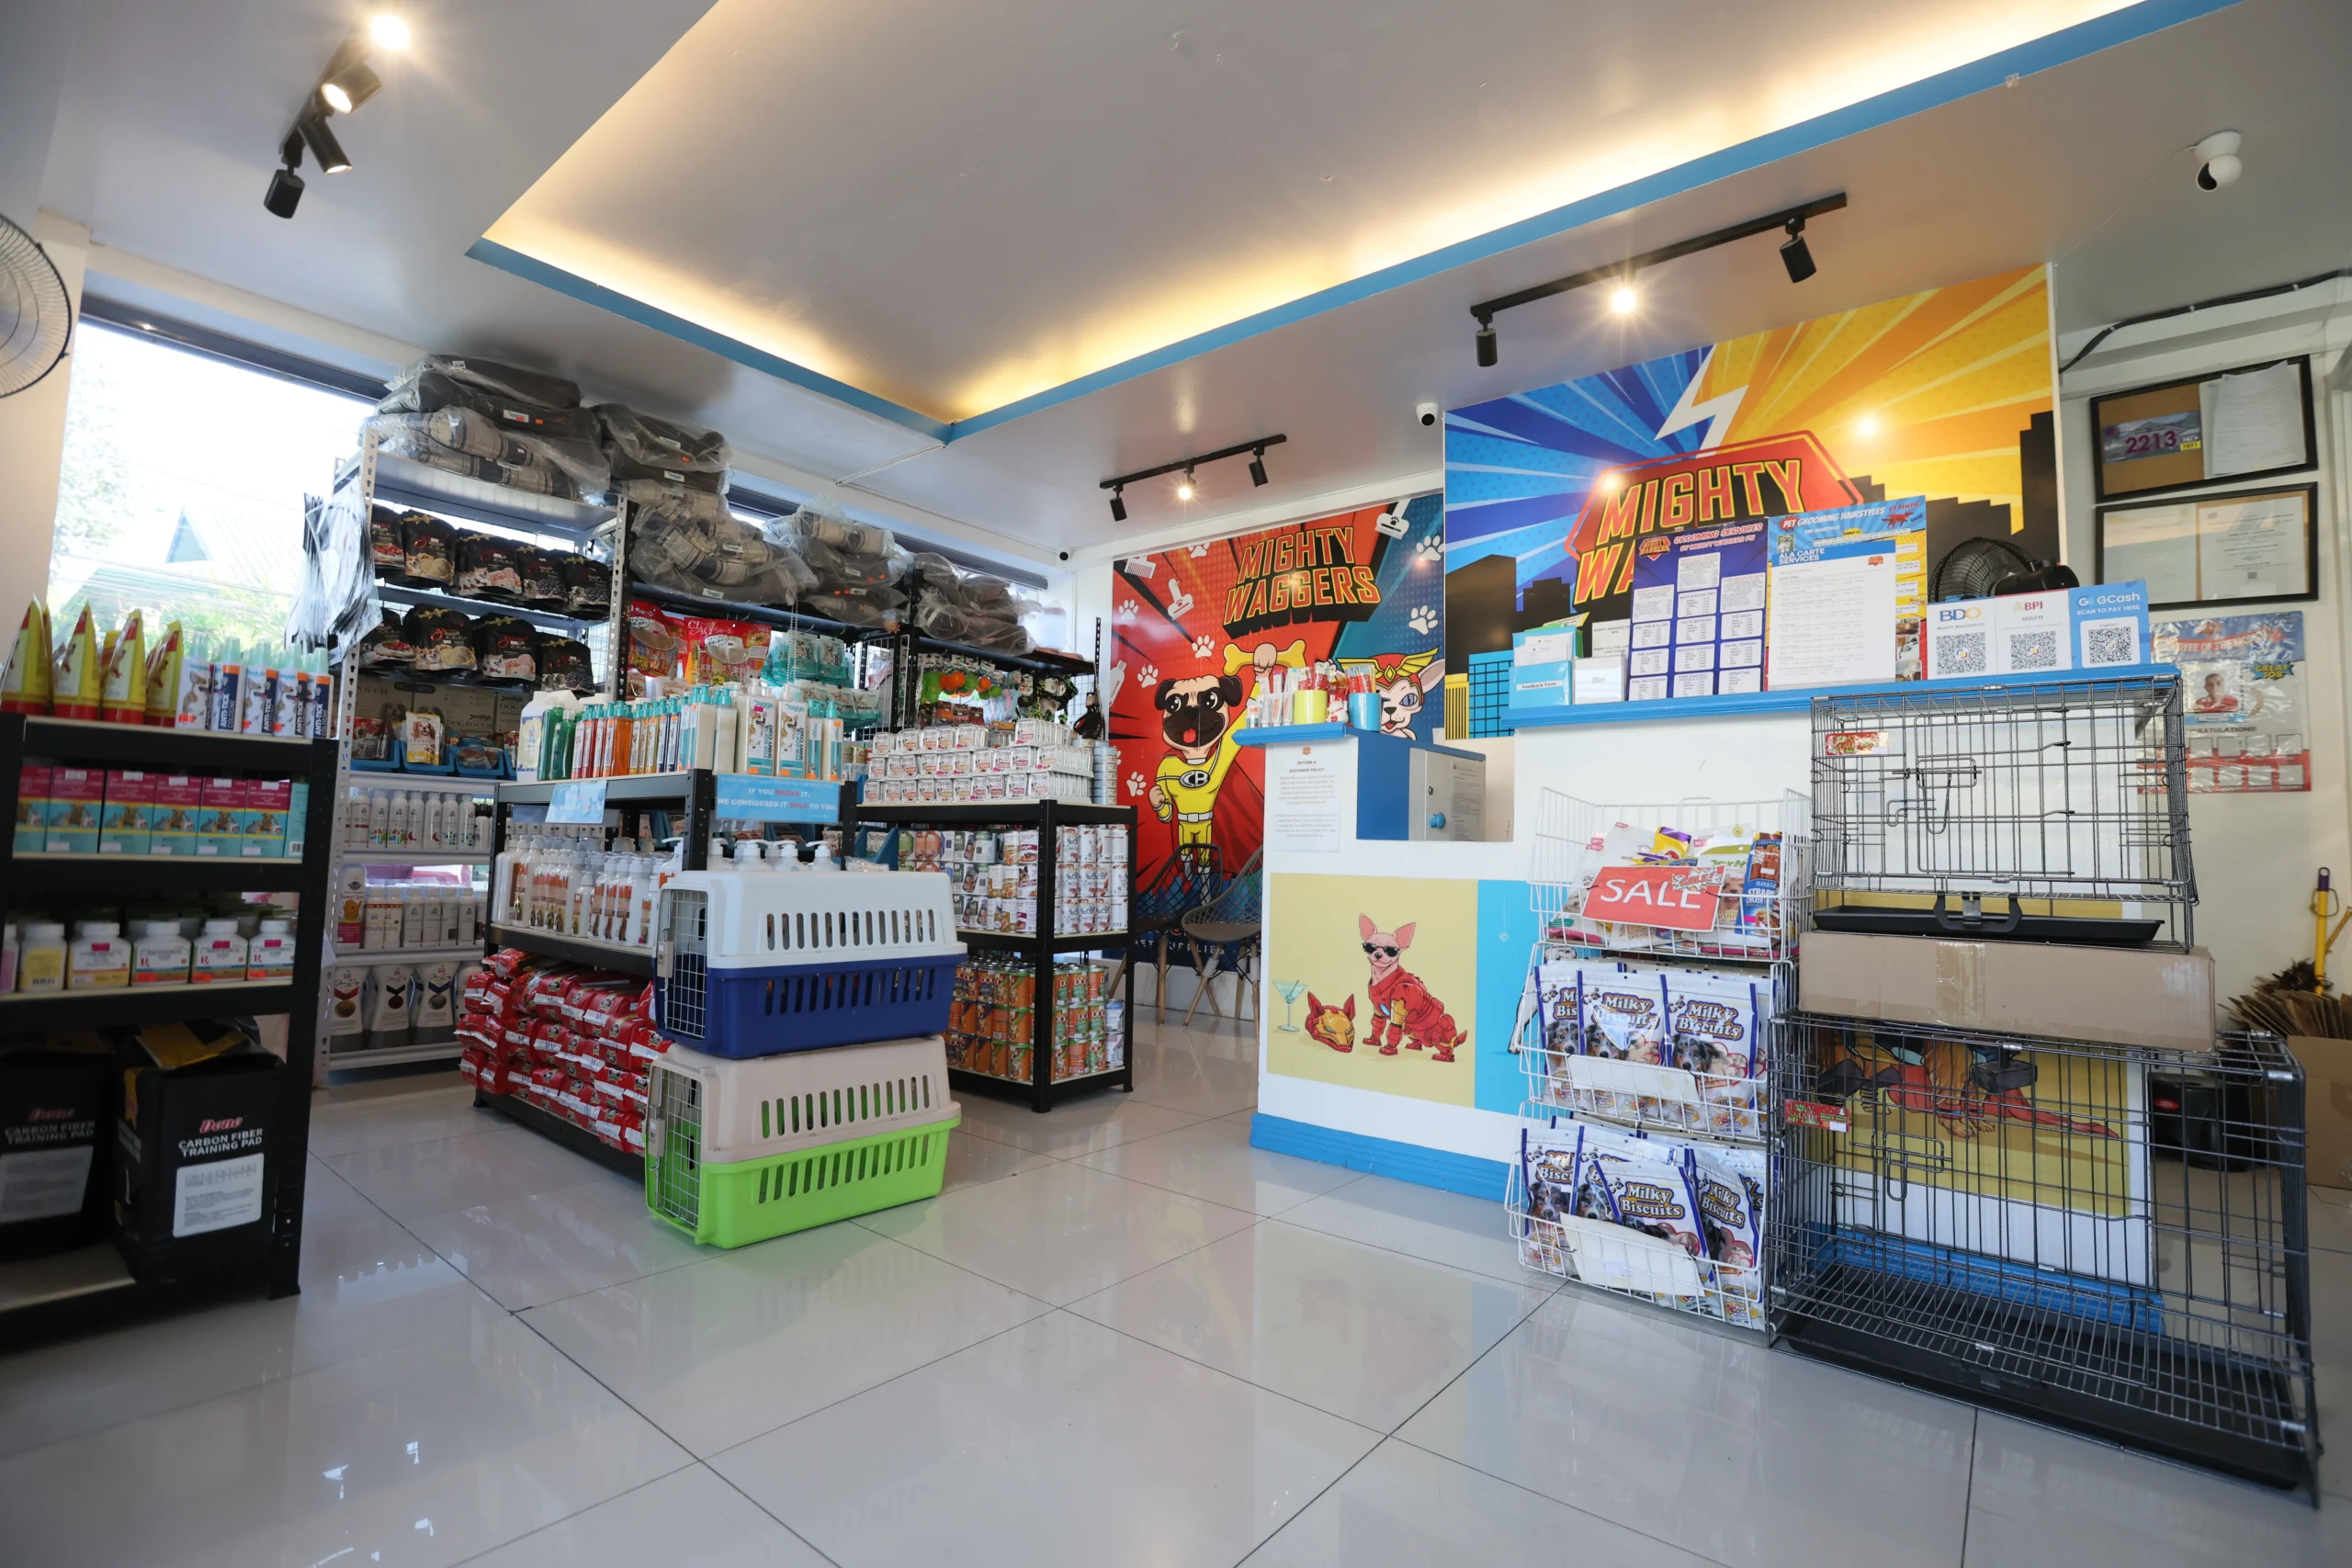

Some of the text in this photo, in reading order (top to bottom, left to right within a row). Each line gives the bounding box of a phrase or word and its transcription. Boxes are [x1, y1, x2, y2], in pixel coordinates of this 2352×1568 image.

[2124, 430, 2177, 454] 2213
[1595, 459, 1805, 546] MIGHTY
[1782, 517, 1797, 528] PET
[1798, 512, 1839, 526] GROOMING
[1840, 506, 1885, 520] HAIRSTYLES
[1674, 523, 1763, 545] GROOMING SERVICES
[1690, 541, 1713, 550] MIGHTY
[1714, 536, 1745, 547] WAGGERS
[1237, 526, 1354, 584] MIGHTY
[1779, 551, 1796, 559] ALA
[1779, 555, 1820, 565] SERVICES
[1223, 566, 1382, 626] WAGGERS
[2097, 592, 2141, 605] GCash
[1939, 606, 1982, 622] BDO
[2024, 601, 2043, 611] BPI
[2255, 663, 2289, 673] GREAT
[2264, 671, 2283, 679] JOB
[220, 694, 230, 728] ANTI-TICK
[753, 699, 774, 709] Doggo
[786, 703, 805, 713] Doggo
[263, 698, 272, 731] ANTI-TICK
[315, 704, 323, 736] ANTI-TICK
[466, 721, 493, 729] POUCH
[731, 798, 779, 807] CONSIDERED
[1600, 879, 1702, 909] SALE
[1603, 996, 1650, 1012] Milky
[1688, 1003, 1736, 1022] Milky
[1678, 1018, 1741, 1038] Biscuits
[5, 1121, 96, 1135] CARBON FIBER
[199, 1117, 243, 1134] Dono
[7, 1129, 94, 1145] TRAINING PAD
[178, 1128, 264, 1150] CARBON FIBER
[182, 1136, 263, 1157] TRAINING PAD
[1627, 1186, 1669, 1203] Milky
[1710, 1184, 1738, 1208] Milky
[1621, 1200, 1682, 1217] Biscuits
[1701, 1193, 1744, 1225] Biscuits
